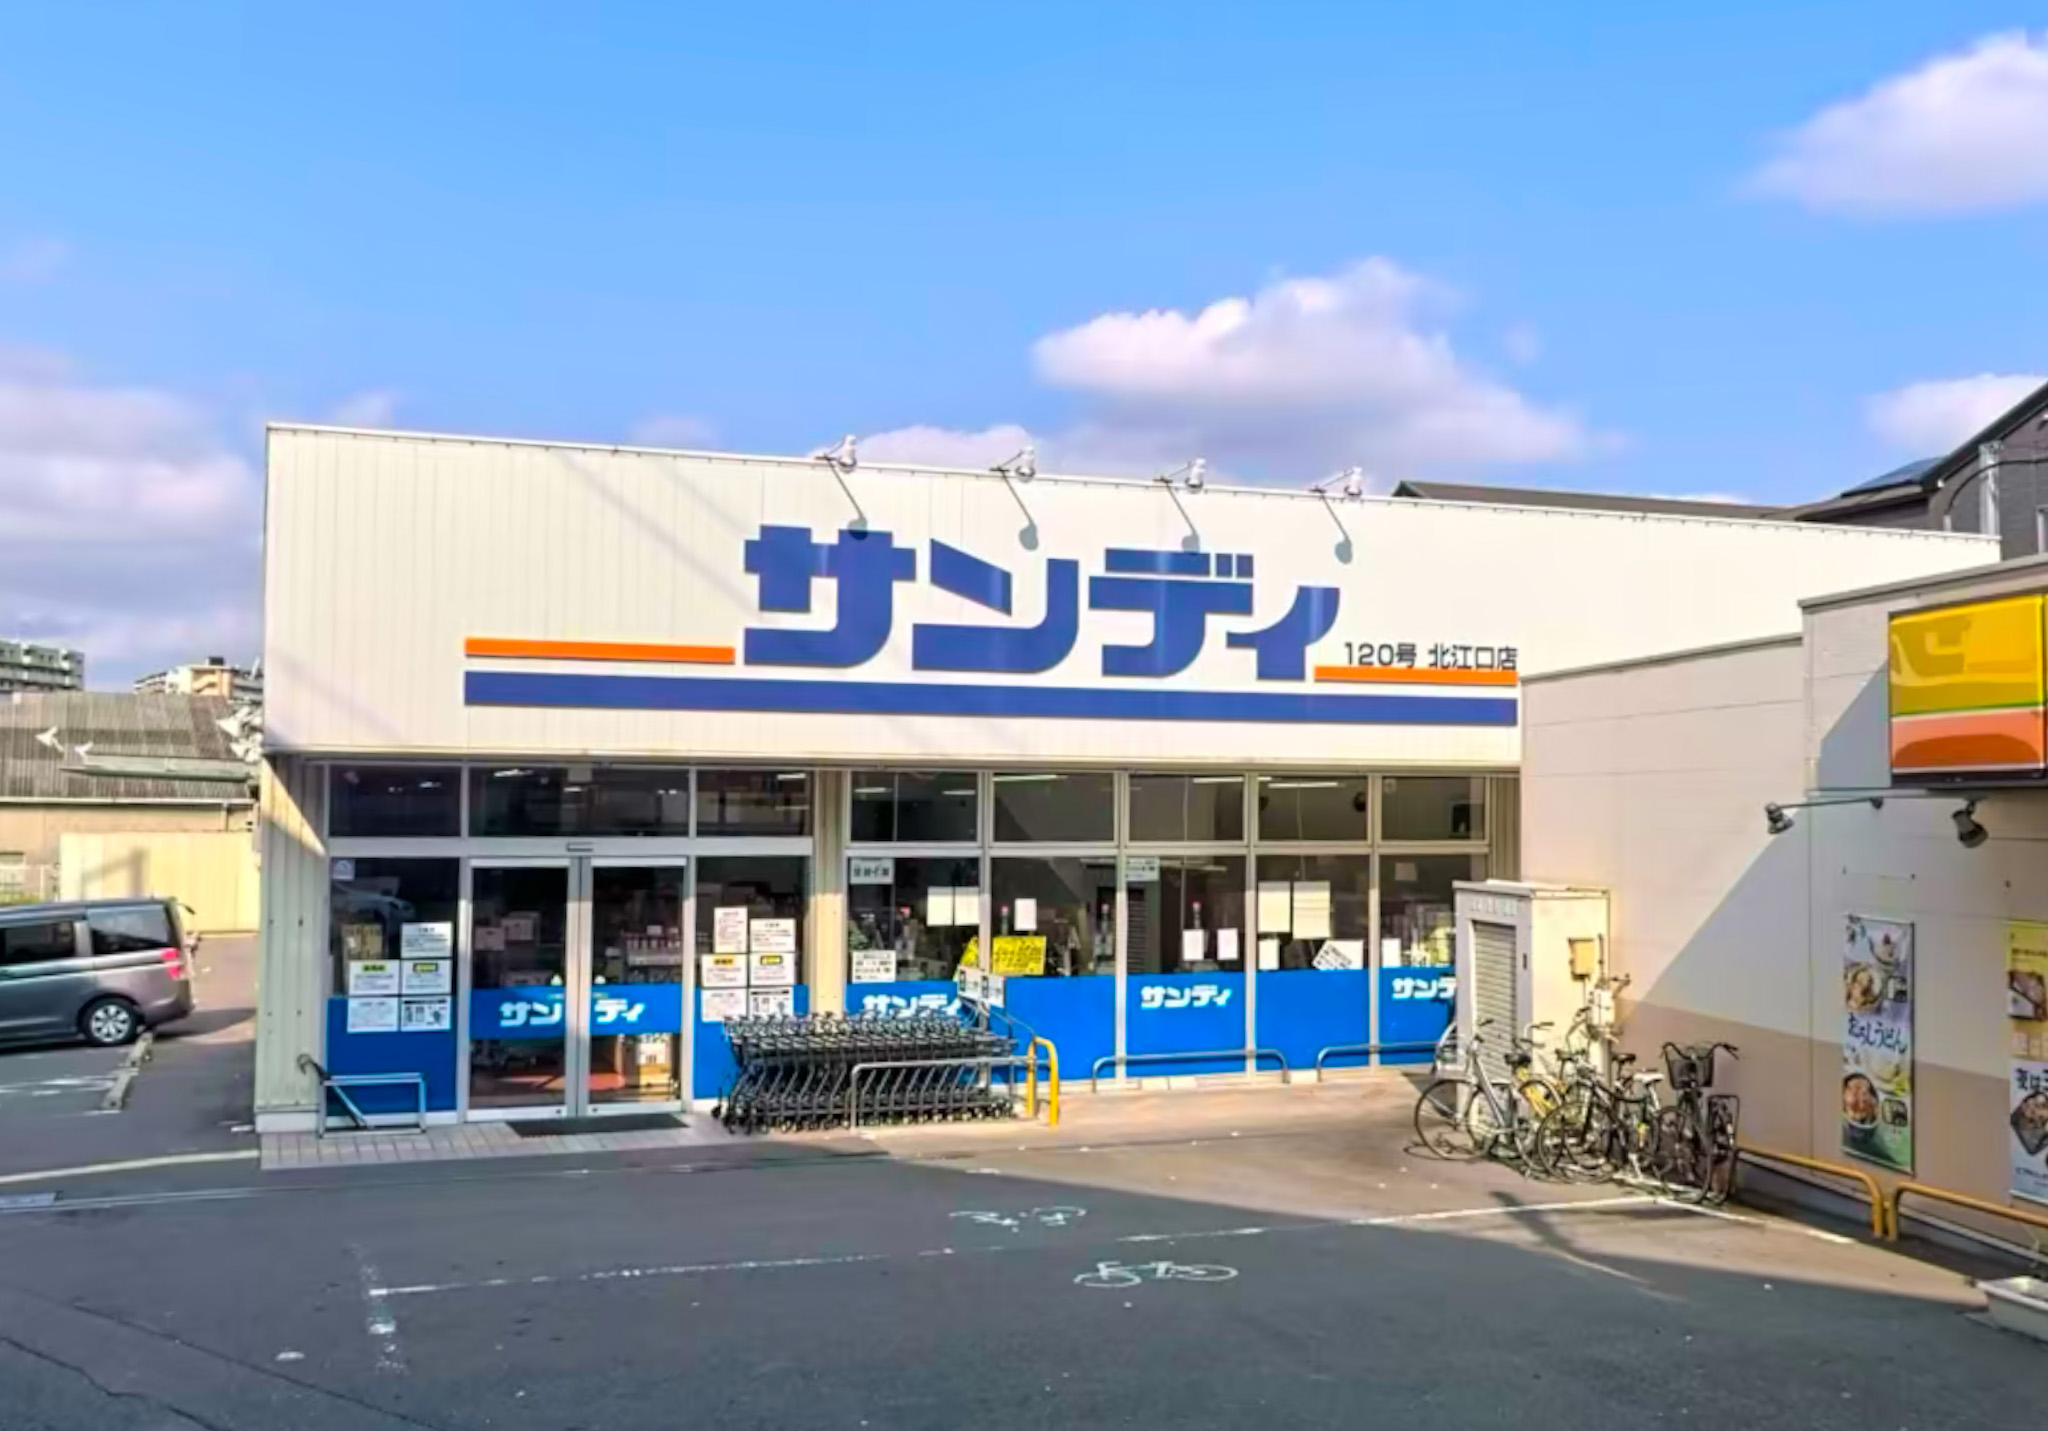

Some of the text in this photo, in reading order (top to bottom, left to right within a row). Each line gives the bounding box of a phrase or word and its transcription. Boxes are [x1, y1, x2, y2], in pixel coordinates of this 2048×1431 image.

[744, 524, 1340, 681] サンディ
[1345, 642, 1517, 671] 120号 北江口店
[1141, 985, 1232, 1009] サンディ
[1392, 977, 1456, 999] サンデ
